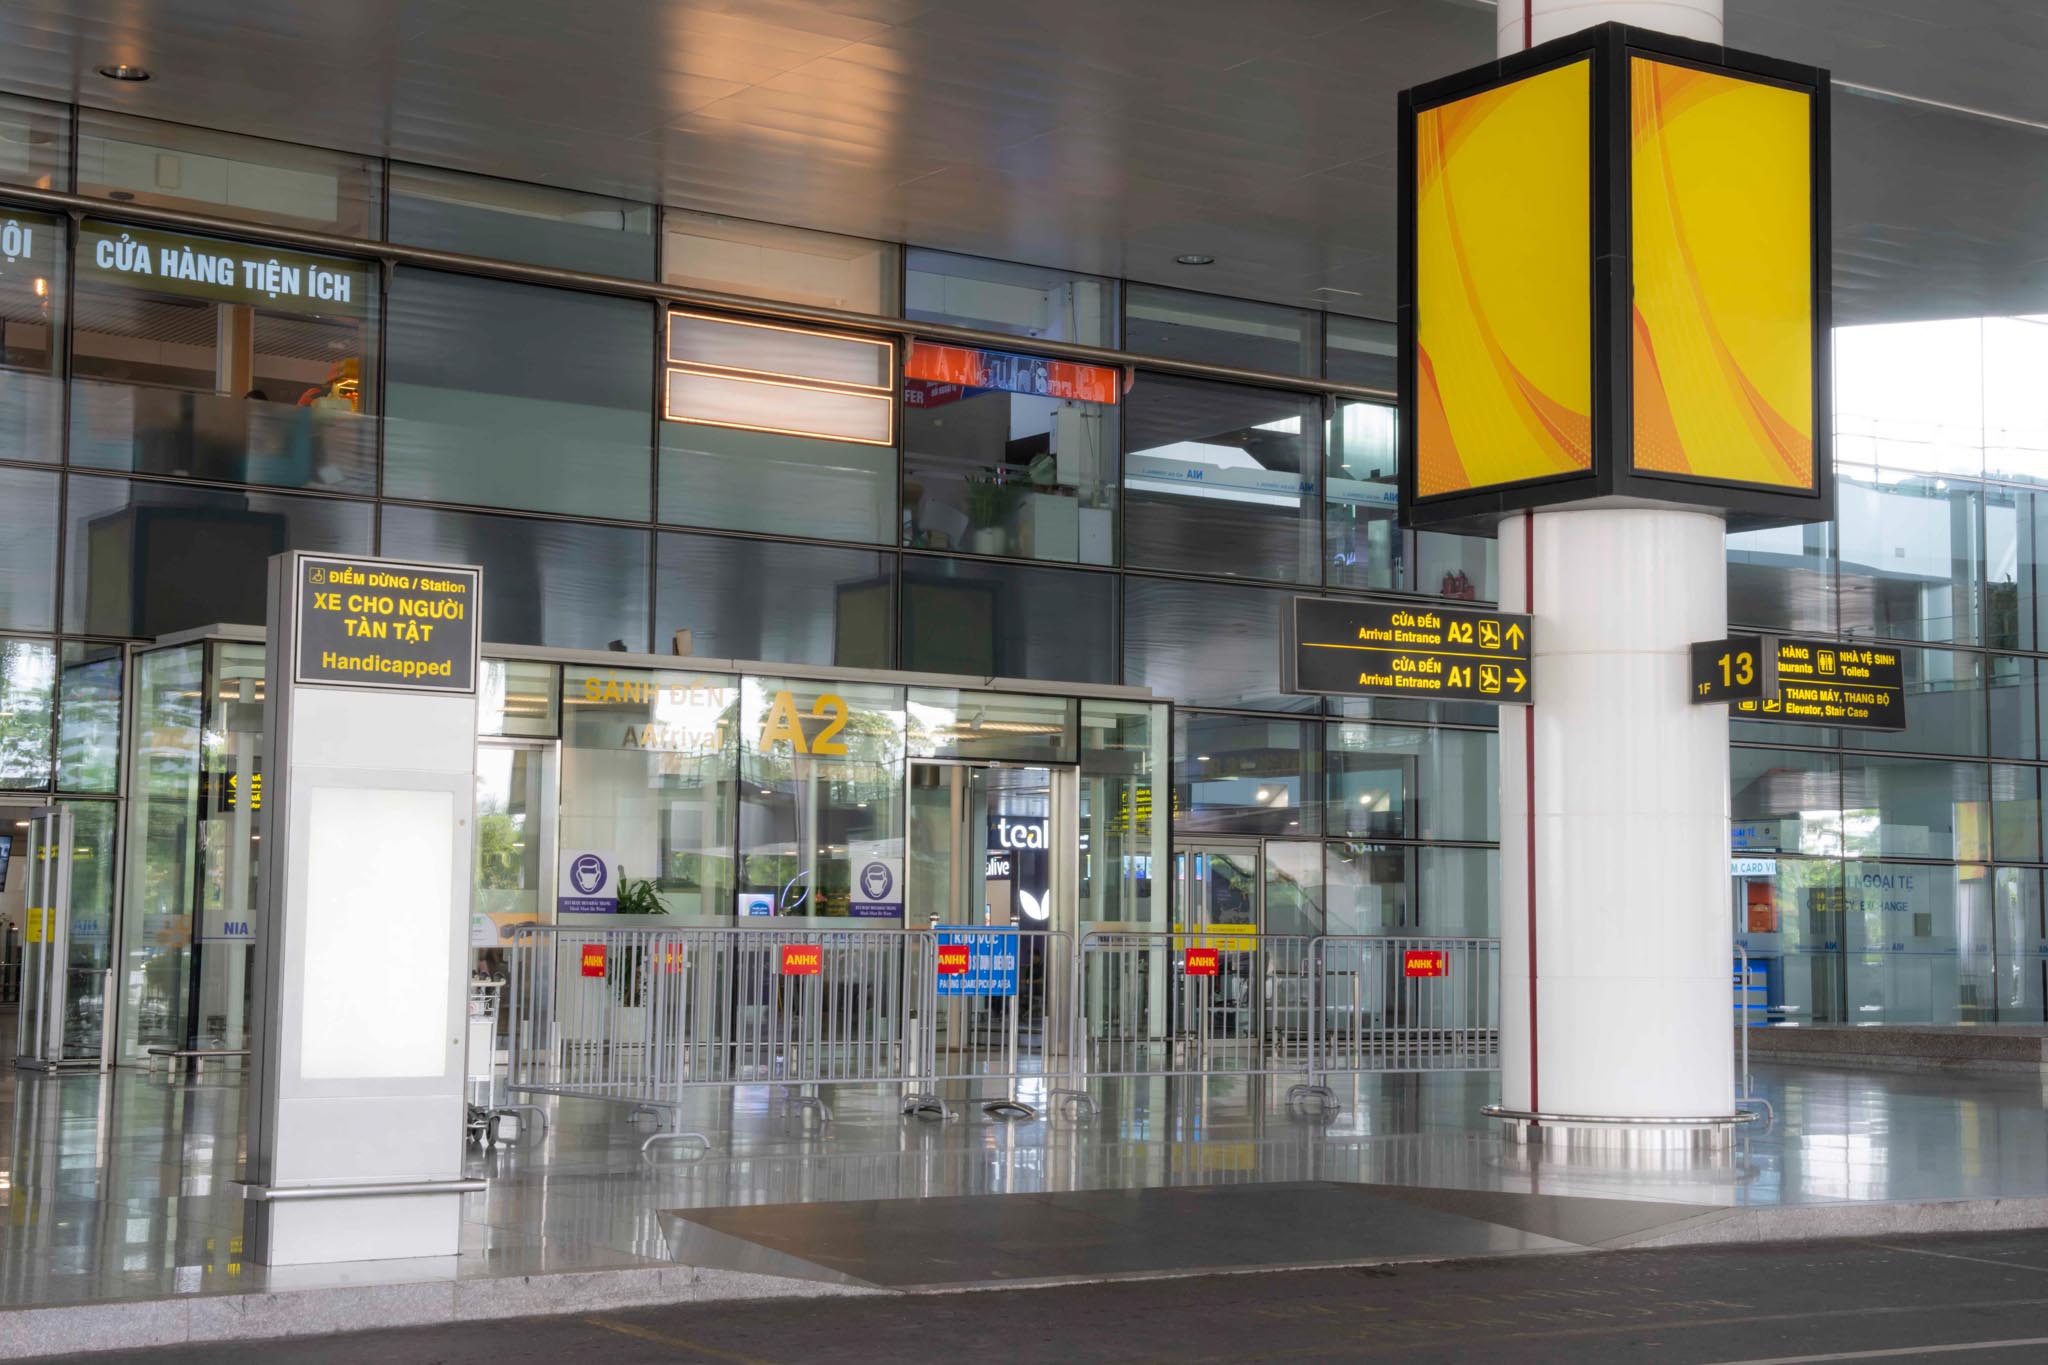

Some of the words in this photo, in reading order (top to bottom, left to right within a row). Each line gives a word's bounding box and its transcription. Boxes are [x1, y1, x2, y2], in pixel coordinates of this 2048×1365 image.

[0, 219, 32, 262] ỘI
[96, 234, 152, 274] CỬA
[160, 246, 234, 286] HÀNG
[242, 259, 300, 298] TIỆN
[308, 265, 351, 302] ÍCH
[329, 566, 365, 586] ĐIỂM
[369, 572, 409, 589] DỪNG
[420, 579, 466, 593] Station
[313, 592, 342, 611] XE
[348, 595, 394, 615] CHO
[399, 598, 464, 620] NGƯỜI
[1392, 611, 1415, 627] CỬA
[1417, 612, 1440, 629] ĐẾN
[344, 616, 387, 639] TÀN
[393, 619, 433, 645] TẬT
[1358, 627, 1392, 641] Arrival
[1395, 630, 1441, 645] Entrance
[1448, 622, 1473, 644] A2
[1782, 645, 1809, 660] HÀNG
[1839, 650, 1858, 663] NHÀ
[1861, 651, 1872, 667] VỆ
[1874, 655, 1895, 666] SINH
[322, 651, 452, 678] Handicapped
[1392, 655, 1416, 672] CỬA
[1418, 657, 1441, 674] ĐẾN
[1718, 651, 1753, 687] 13
[1841, 666, 1870, 678] Toilets
[1359, 672, 1392, 687] Arrival
[1395, 674, 1441, 689] Entrance
[1448, 666, 1472, 688] A1
[585, 672, 658, 704] SẢNH
[1698, 682, 1711, 696] 1F
[1786, 688, 1818, 701] THANG
[1820, 688, 1842, 703] MÁY,
[1843, 692, 1874, 704] THANG
[1876, 692, 1890, 708] BỘ
[1786, 703, 1823, 716] Elevator,
[1825, 705, 1845, 717] Stair
[1847, 706, 1869, 718] Case
[760, 691, 849, 755] A2
[1741, 862, 1763, 873] CARD
[224, 922, 248, 935] NIA
[584, 955, 603, 967] ANHK
[786, 954, 817, 965] ANHK
[1188, 956, 1215, 967] ANHK
[1408, 959, 1433, 969] ANHK
